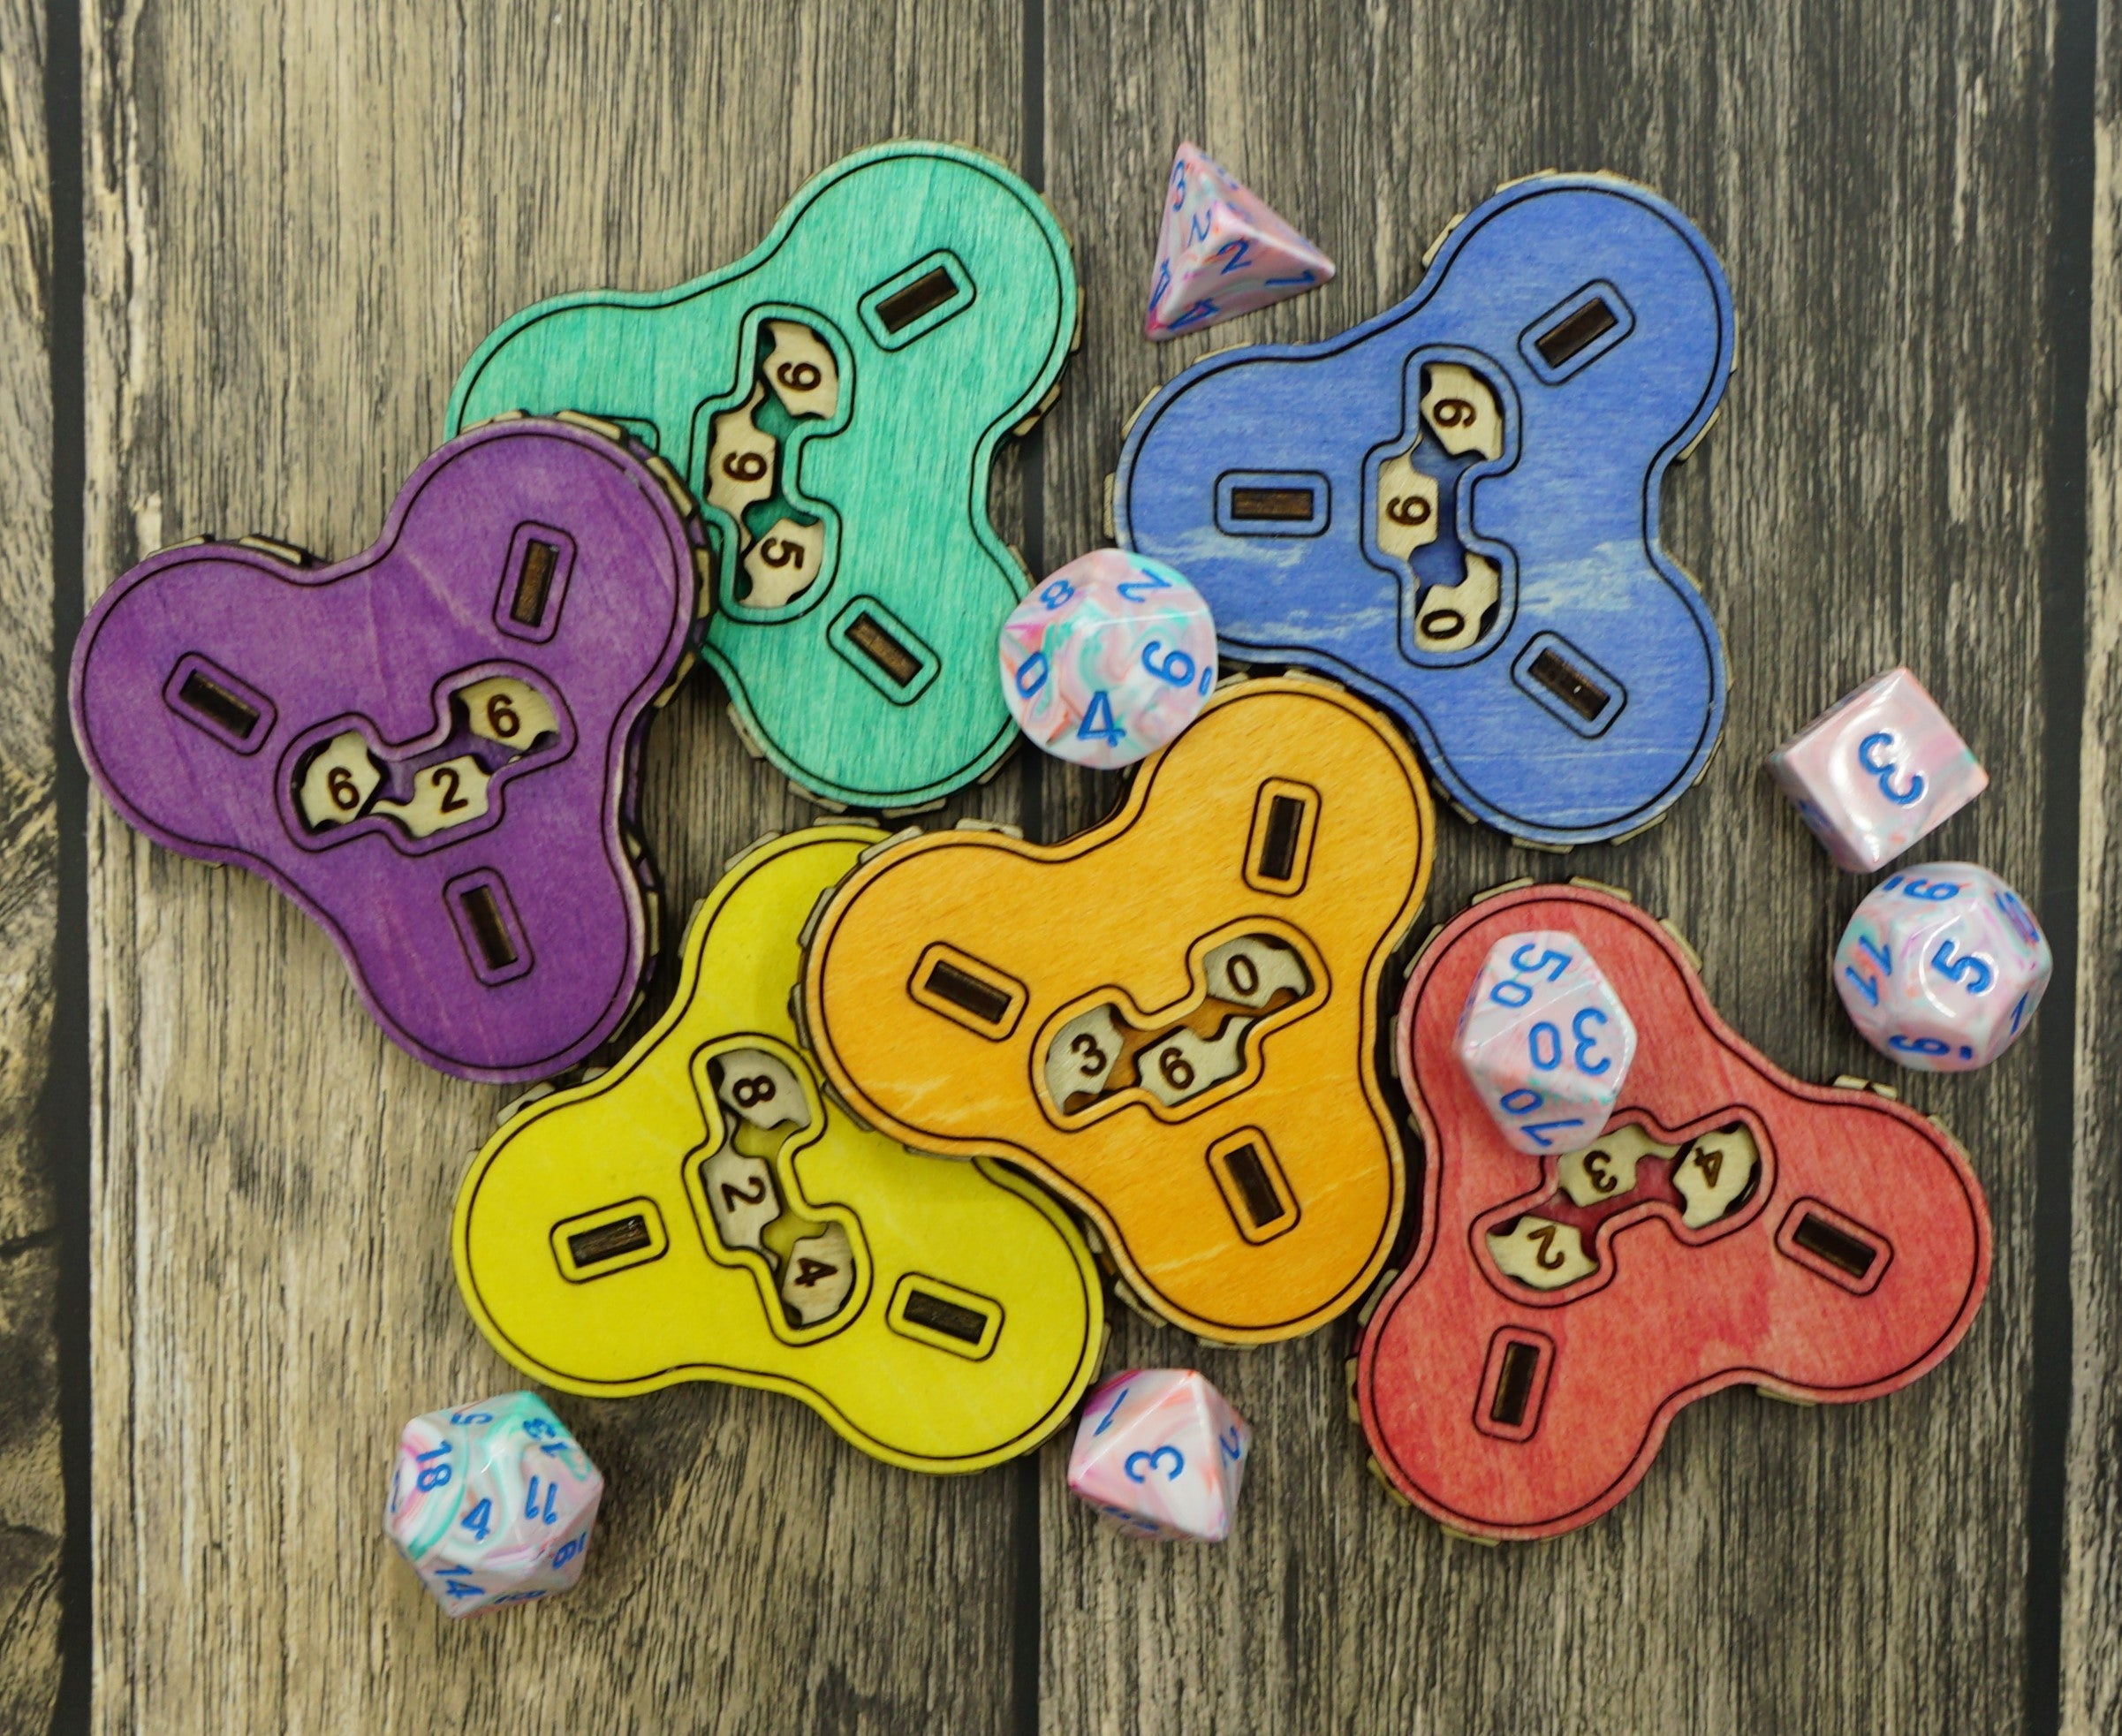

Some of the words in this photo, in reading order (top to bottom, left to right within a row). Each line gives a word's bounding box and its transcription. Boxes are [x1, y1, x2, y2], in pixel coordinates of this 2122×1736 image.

[1216, 239, 1252, 276] 2
[761, 537, 805, 569] 5
[1040, 580, 1075, 610] 8
[1421, 609, 1465, 640] 0
[1016, 651, 1049, 700] 0
[1077, 691, 1125, 747] 4
[328, 767, 360, 810] 6
[432, 768, 468, 814] 2
[488, 694, 520, 738] 6
[1859, 732, 1924, 805] 3
[1489, 943, 1572, 1009] 50
[1931, 939, 1992, 995] 5
[1071, 1034, 1107, 1077] 3
[1159, 1047, 1194, 1090] 6
[1226, 954, 1259, 996] 0
[1528, 1007, 1611, 1075] 30
[732, 1075, 776, 1108] 8
[1583, 1150, 1618, 1193] 3
[1694, 1147, 1724, 1188] 4
[721, 1177, 766, 1213] 2
[1527, 1225, 1565, 1270] 2
[795, 1257, 838, 1287] 4
[416, 1439, 452, 1493] 18
[1124, 1445, 1185, 1485] 3
[461, 1498, 492, 1541] 4
[525, 1474, 558, 1526] 11
